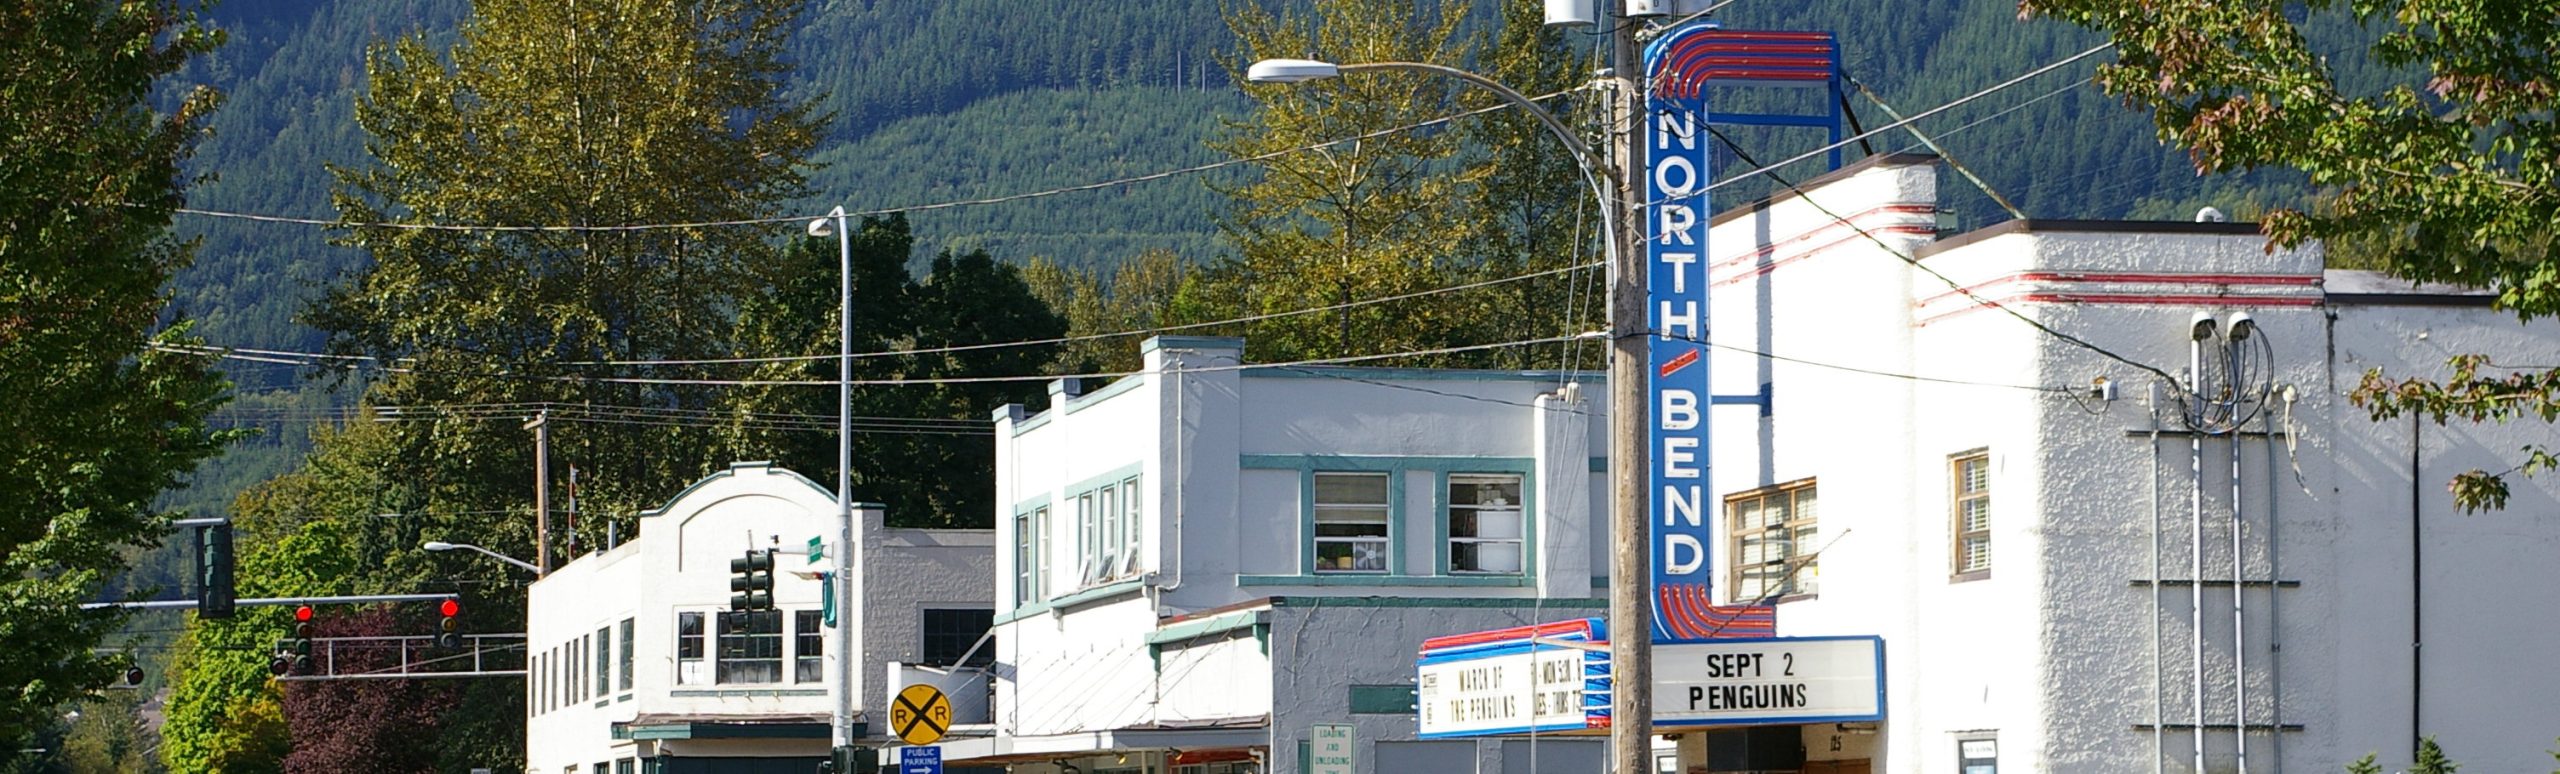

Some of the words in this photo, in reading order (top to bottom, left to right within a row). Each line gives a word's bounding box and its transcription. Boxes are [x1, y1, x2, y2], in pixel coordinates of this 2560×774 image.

[1655, 109, 1697, 342] NORTH
[1661, 389, 1704, 575] BEND
[1459, 668, 1488, 692] MARCH
[1493, 665, 1502, 689] OF
[1707, 653, 1763, 678] SEPT
[1783, 652, 1794, 677] 2
[1450, 699, 1465, 722] THE
[1470, 695, 1515, 721] PENGUINS
[1689, 683, 1806, 710] PENGUINS
[906, 748, 935, 757] PUBLIC
[1326, 743, 1339, 751] AND
[904, 757, 938, 766] PARKING
